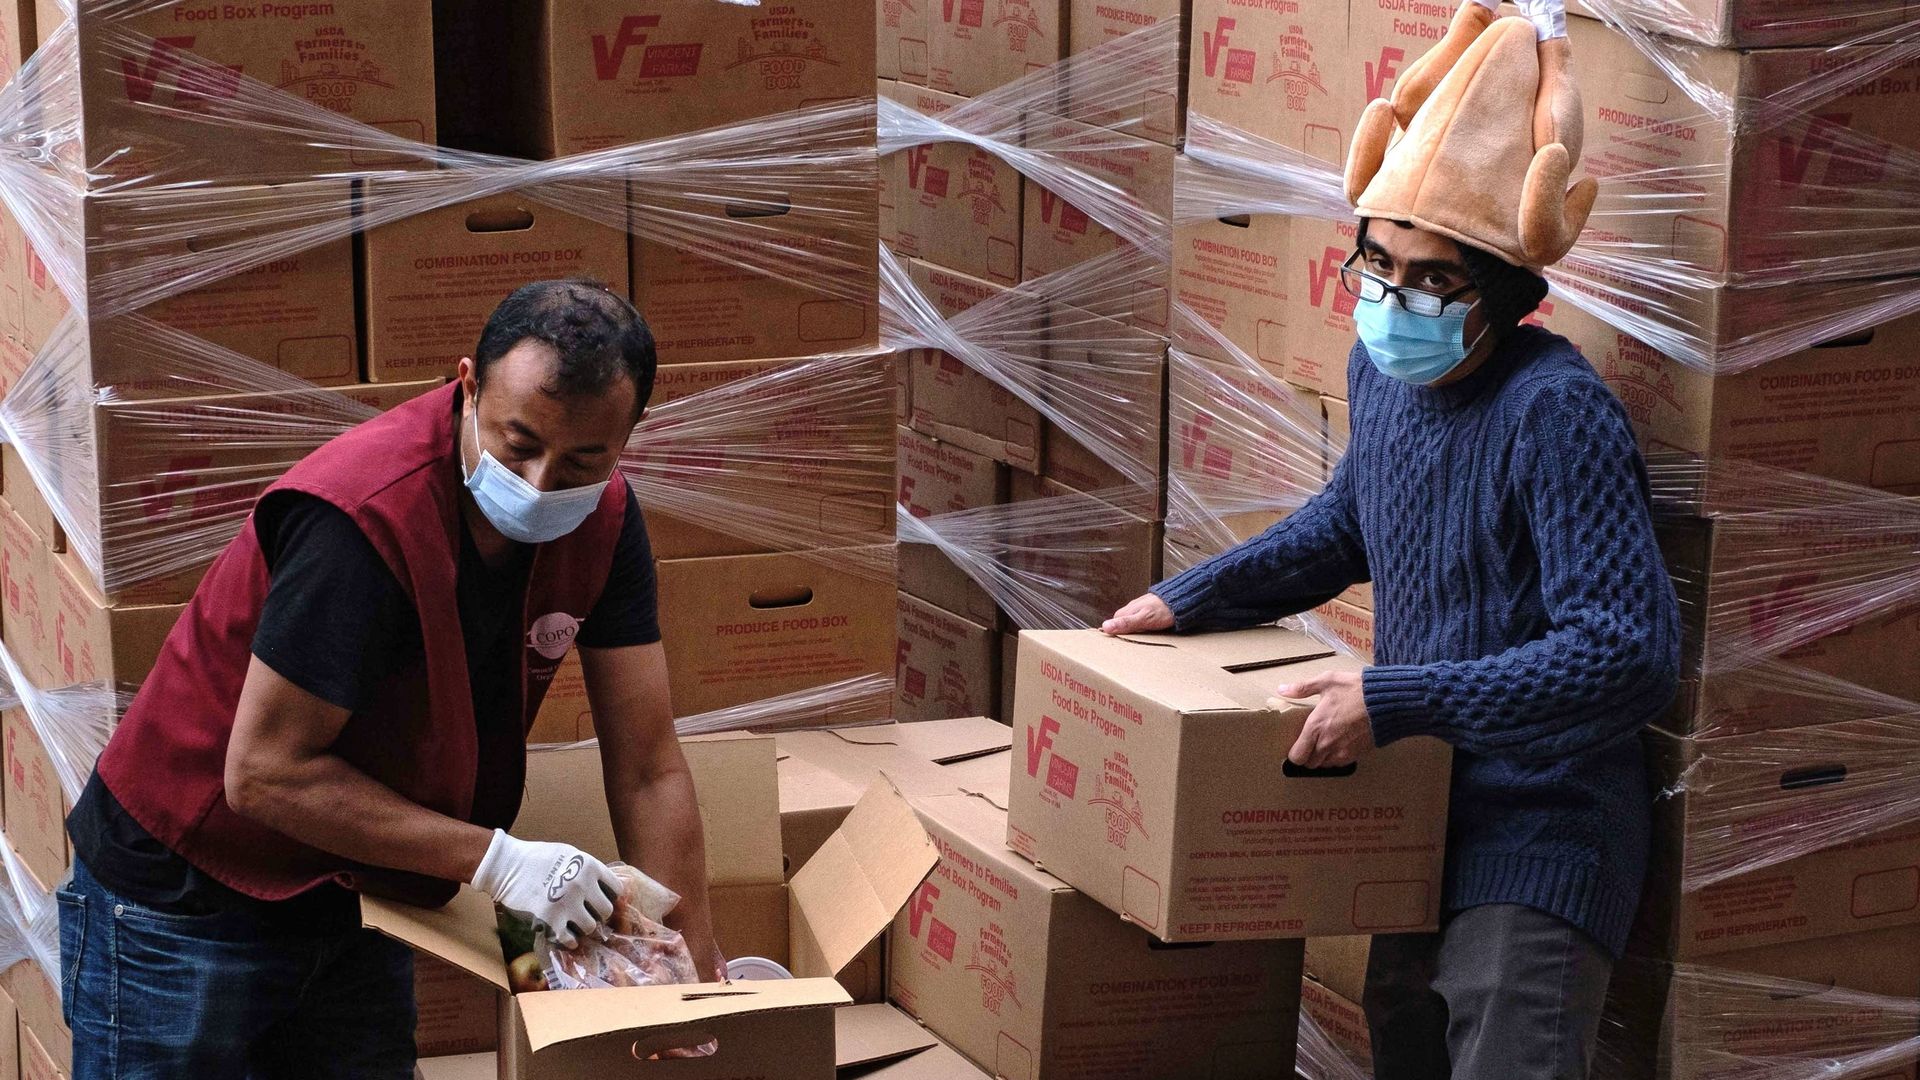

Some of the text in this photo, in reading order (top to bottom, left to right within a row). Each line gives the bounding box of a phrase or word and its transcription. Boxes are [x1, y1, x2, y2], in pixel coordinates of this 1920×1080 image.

[174, 3, 334, 21] Food Box Program
[769, 7, 795, 15] USDA
[1096, 6, 1125, 21] PRODUCE
[1126, 11, 1143, 24] FOOD
[1265, 0, 1298, 14] Program
[1379, 0, 1405, 12] USDA
[1408, 0, 1446, 18] Farmers
[315, 27, 344, 36] USDA
[752, 16, 814, 29] Farmers to
[1394, 18, 1417, 36] Food
[1420, 23, 1438, 40] Box
[754, 28, 808, 40] Families
[1280, 35, 1307, 49] Farmers
[295, 38, 351, 50] Farmers
[591, 15, 661, 80] VF
[647, 48, 696, 58] VINCENT
[1203, 16, 1236, 77] VF
[300, 51, 359, 62] Families
[1281, 47, 1310, 62] Families
[652, 63, 694, 73] FARMS
[760, 59, 805, 73] FOOD
[1231, 67, 1250, 80] FARMS
[1365, 46, 1405, 104] VF
[306, 82, 357, 98] FOOD
[766, 75, 800, 89] BOX
[1285, 79, 1309, 96] FOOD
[1287, 95, 1306, 112] BOX
[1598, 107, 1697, 142] PRODUCE FOOD BOX
[415, 249, 583, 270] COMBINATION FOOD BOX
[1193, 238, 1278, 267] COMBINATION FOOD BOX
[270, 260, 299, 272] BOX
[1309, 246, 1347, 307] VF
[657, 336, 755, 350] EEP REFRIGERATED
[385, 358, 415, 369] KEEP
[1619, 347, 1662, 372] Families
[654, 368, 750, 385] SDA Farmers
[1760, 366, 1920, 390] COMBINATION FOOD BOX
[1621, 383, 1657, 408] FOOD
[716, 616, 848, 637] PRODUCE FOOD BOX
[1335, 606, 1370, 631] Farmers
[536, 625, 576, 643] COPO
[1346, 631, 1363, 650] Box
[1041, 660, 1143, 726] USDA Farmers to Families
[1052, 689, 1126, 741] Food Box Program
[1027, 714, 1061, 778] VF
[1114, 751, 1129, 766] USDA
[1104, 758, 1132, 785] Farmers
[1104, 772, 1134, 798] Families
[1105, 808, 1131, 834] FOOD
[1222, 806, 1404, 824] COMBINATION FOOD BOX
[1107, 826, 1127, 850] BOX
[543, 855, 565, 888] HENRY
[948, 848, 973, 873] Farmers
[976, 864, 983, 877] to
[985, 868, 1018, 900] Families
[936, 864, 1001, 912] ood Box Program
[909, 880, 940, 940] VF
[1179, 919, 1304, 935] KEEP REFRIGERATED
[1696, 916, 1807, 942] KEEP REFRIGERATED
[980, 927, 1007, 952] Farmers
[980, 941, 1008, 968] Families
[1090, 978, 1186, 995] COMBINATION
